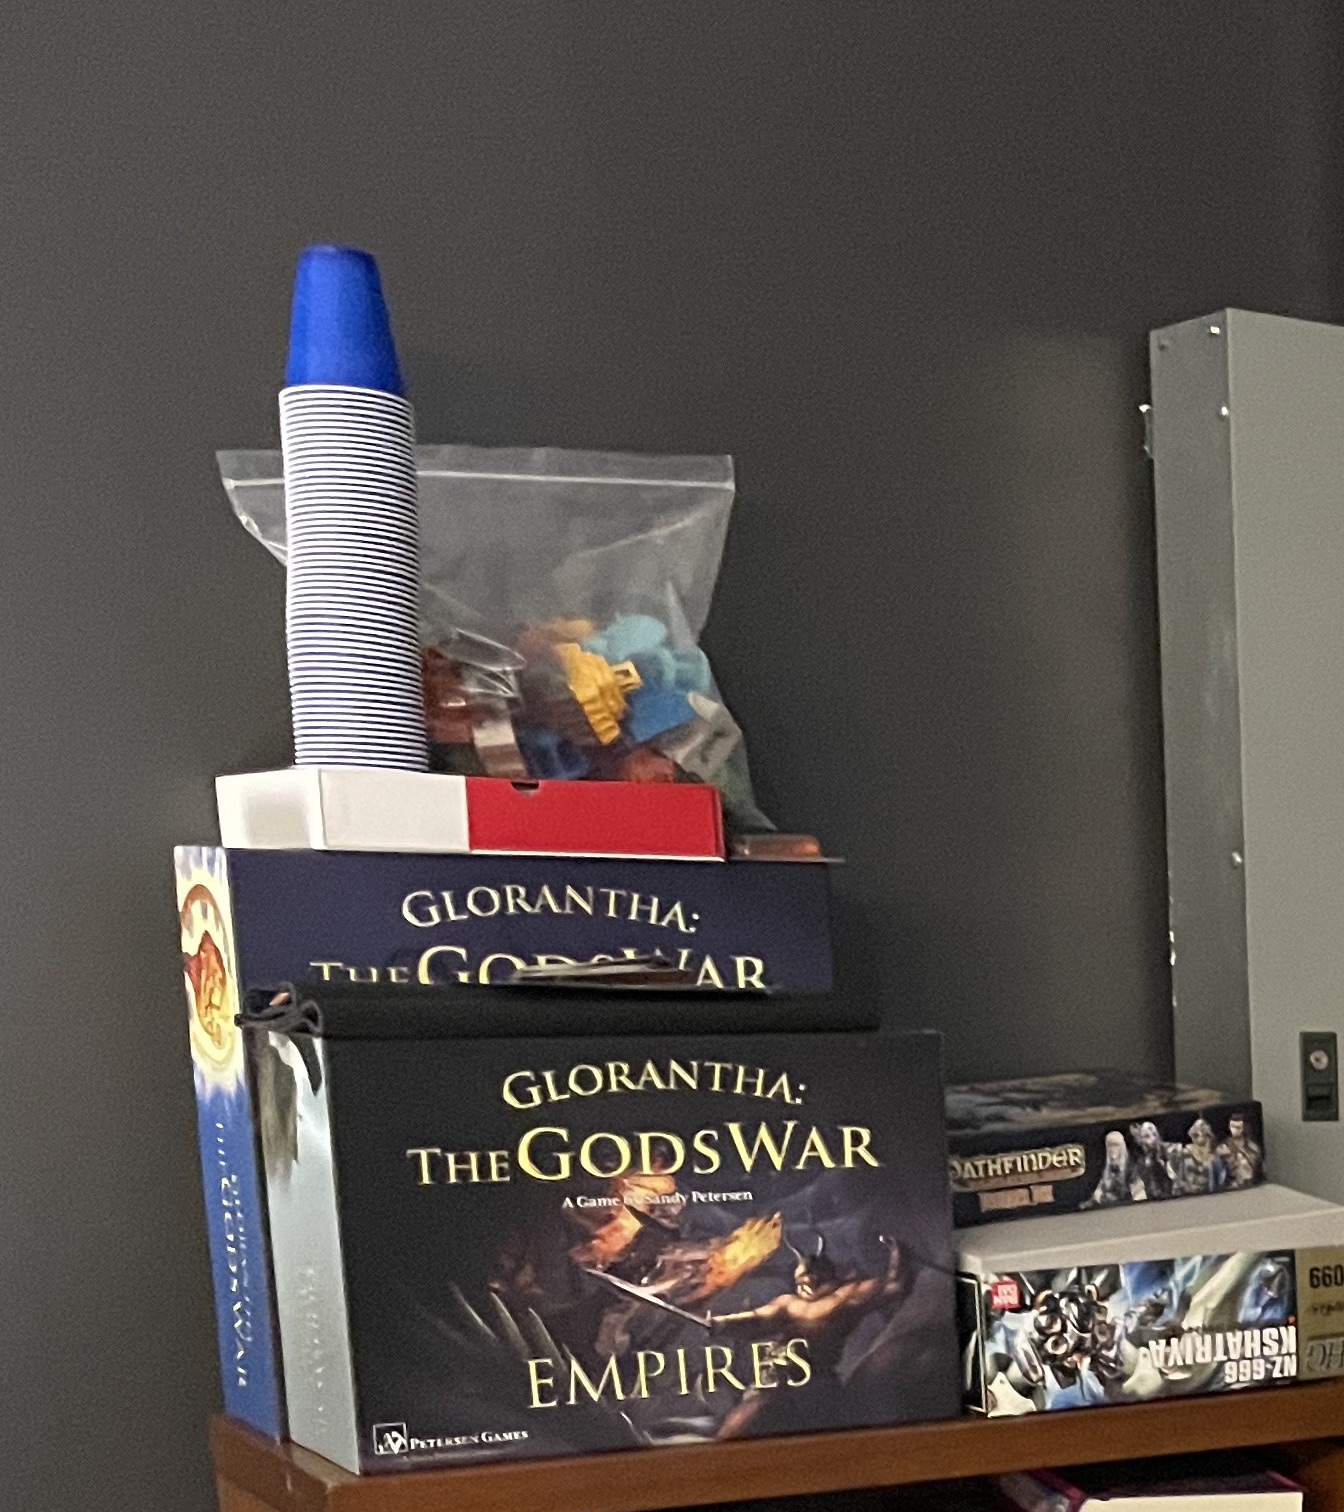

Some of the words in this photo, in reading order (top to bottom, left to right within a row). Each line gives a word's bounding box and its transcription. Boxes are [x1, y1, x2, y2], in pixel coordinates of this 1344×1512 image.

[401, 884, 701, 934] GLORANTHA:
[502, 1059, 806, 1110] GLORANTHA:
[408, 1147, 510, 1188] THE
[516, 1120, 880, 1182] GODSWAR
[562, 1196, 574, 1209] A
[576, 1195, 619, 1208] Game
[691, 1190, 754, 1203] Petersen
[1148, 1325, 1297, 1369] KSHATRIYA
[526, 1338, 813, 1411] EMPIRES
[481, 1430, 530, 1444] GAMES
